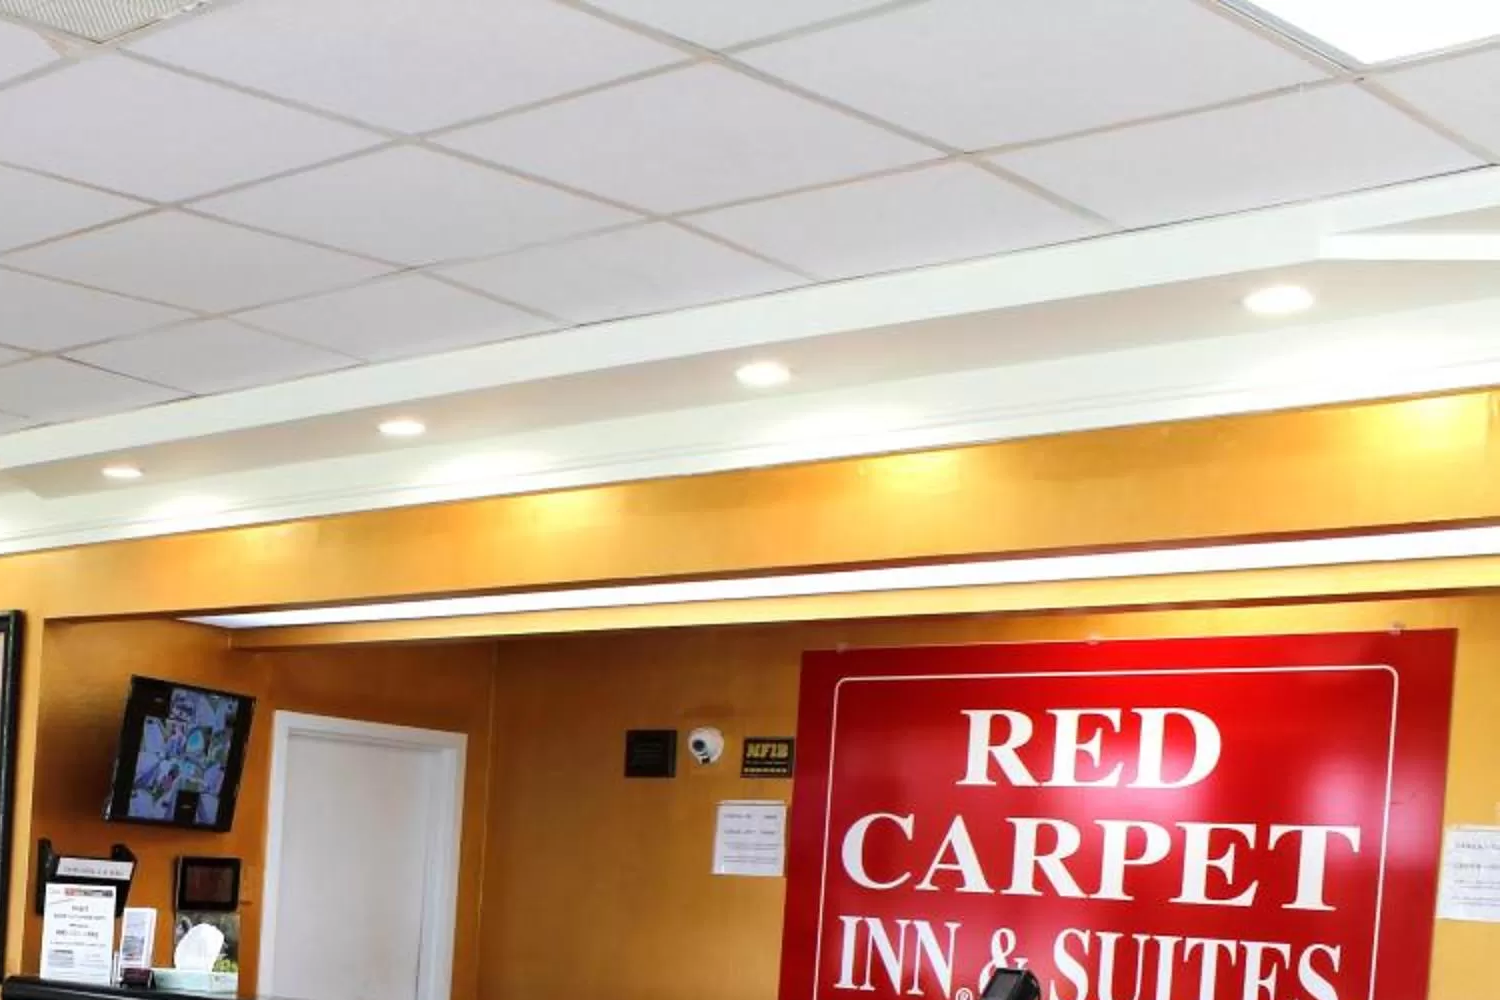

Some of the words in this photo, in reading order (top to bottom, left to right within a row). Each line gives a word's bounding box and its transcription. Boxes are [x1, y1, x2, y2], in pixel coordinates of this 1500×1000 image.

[956, 707, 1222, 789] RED
[841, 813, 1361, 911] CARPET
[834, 915, 961, 1000] INN
